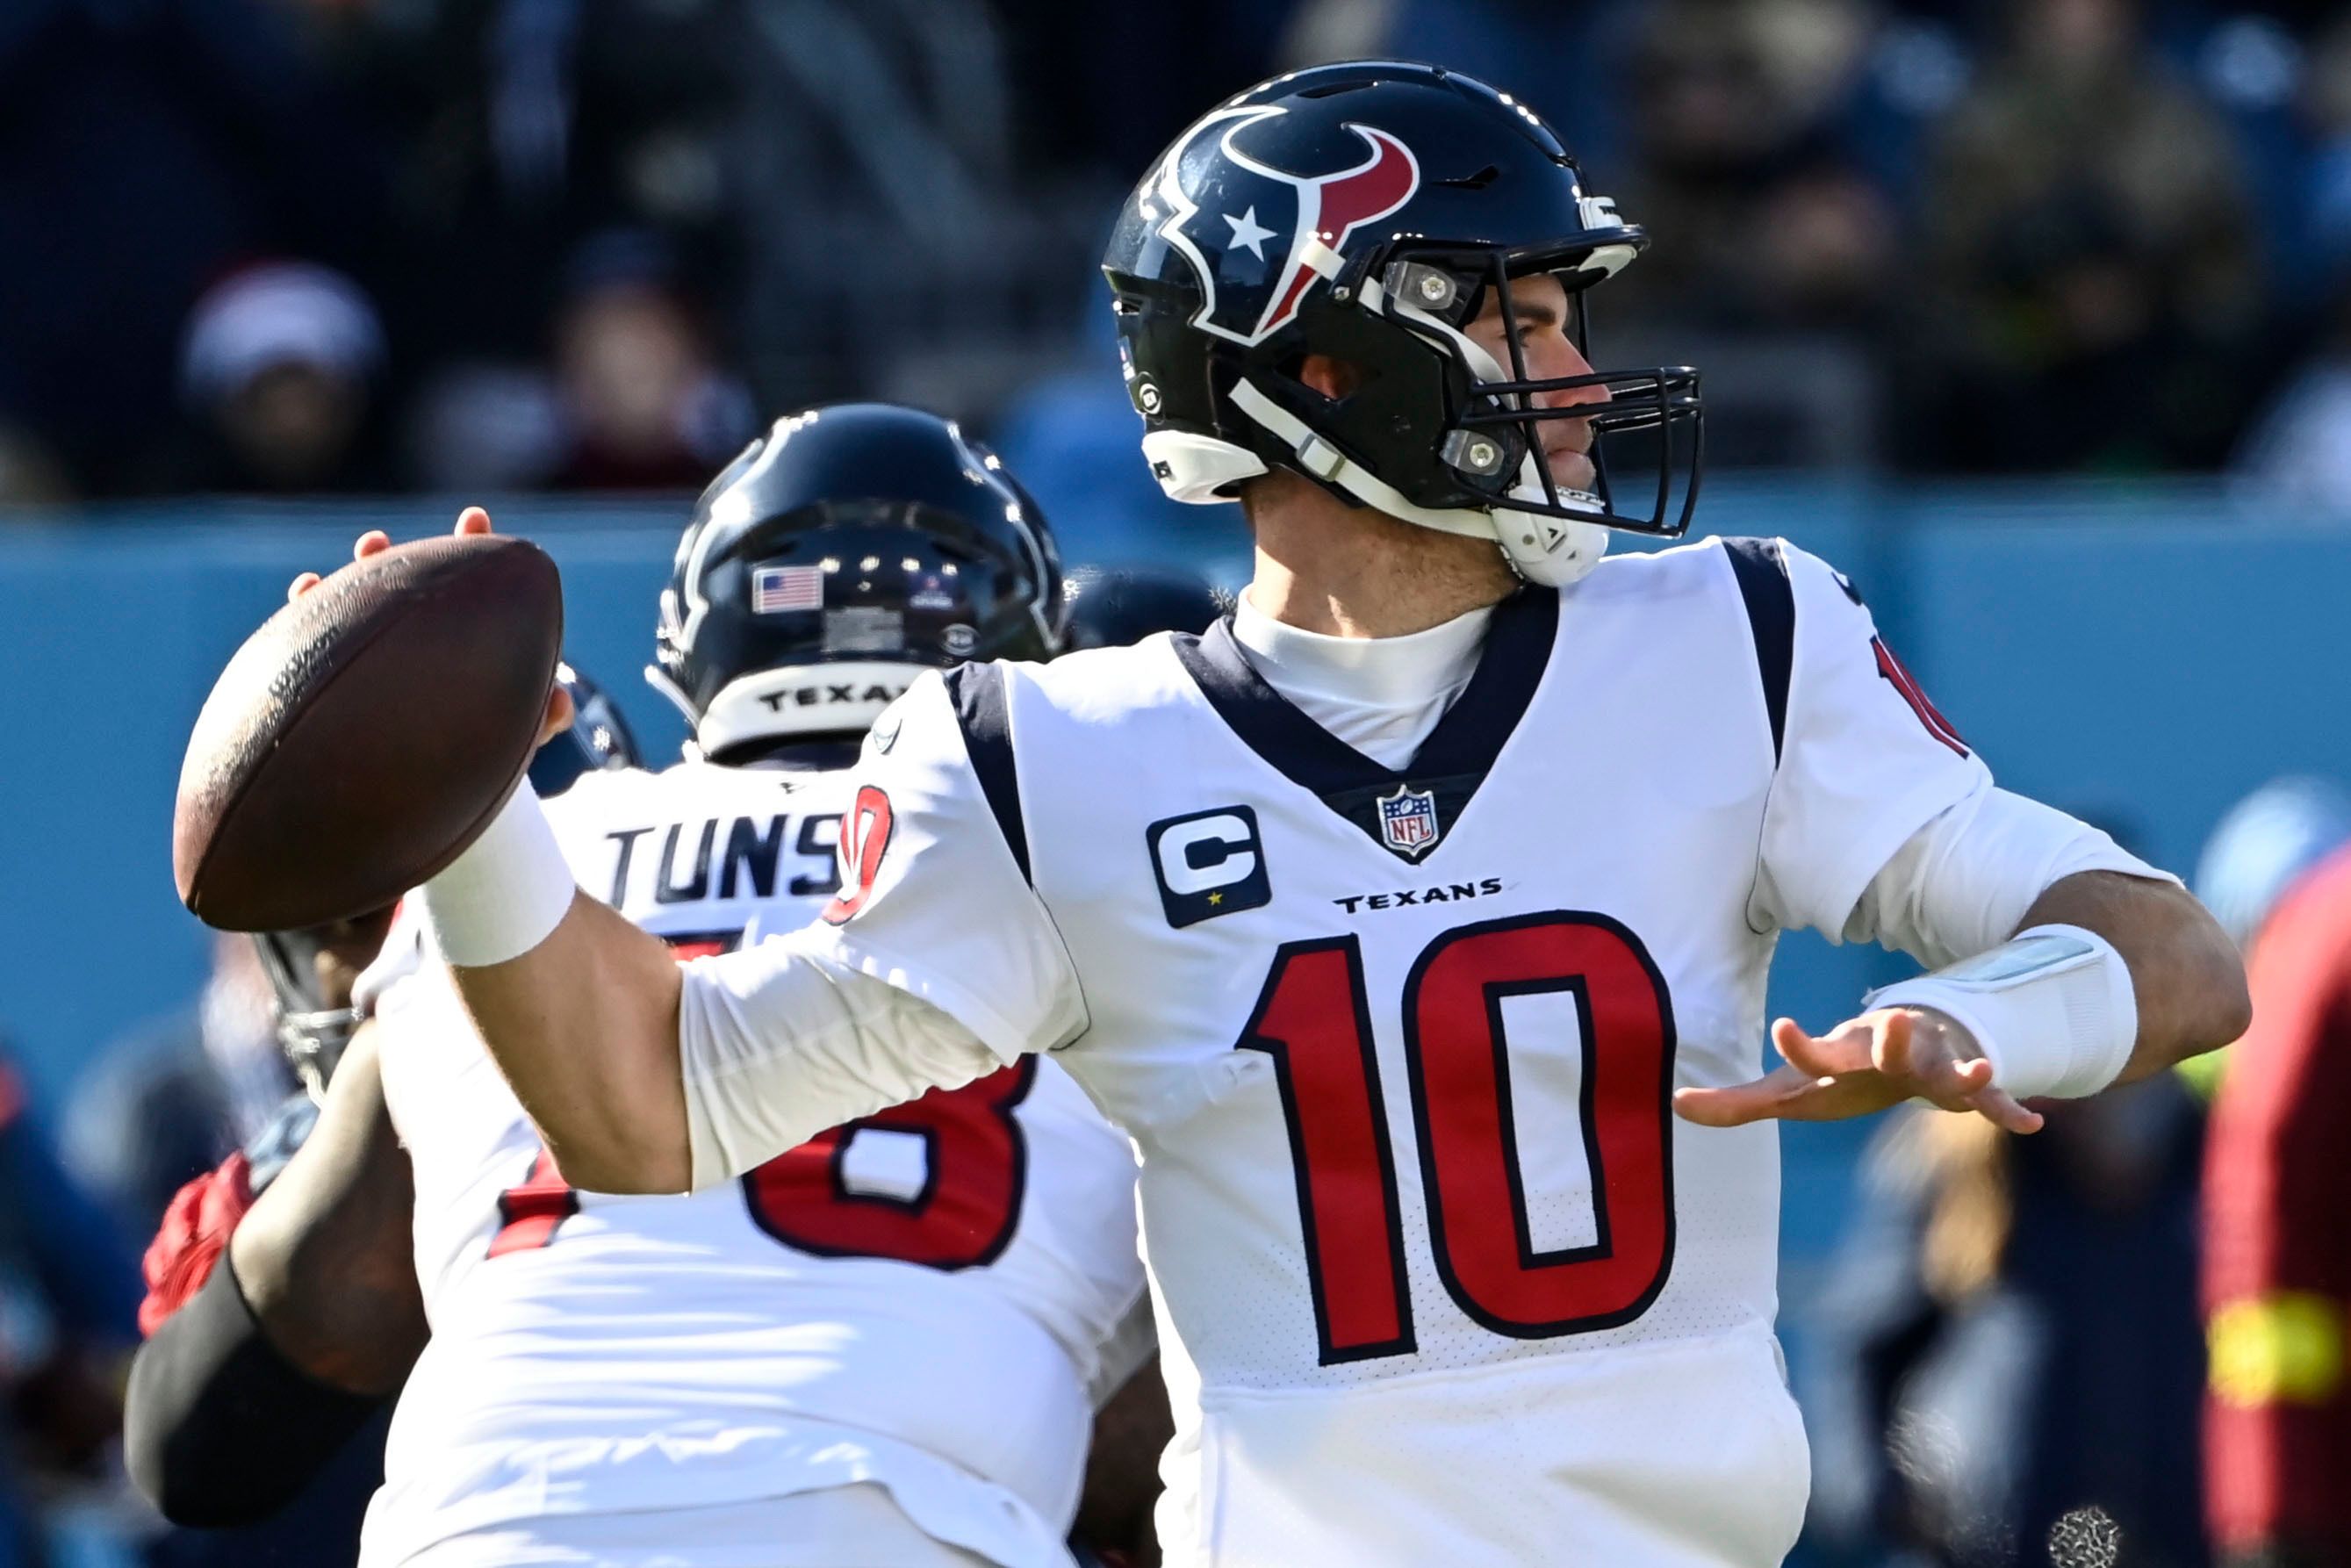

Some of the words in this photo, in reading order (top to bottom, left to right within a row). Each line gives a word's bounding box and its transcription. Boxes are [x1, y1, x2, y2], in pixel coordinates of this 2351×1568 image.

[759, 684, 909, 712] TEXA
[1391, 816, 1431, 843] NFL
[1157, 815, 1256, 895] C
[1333, 878, 1503, 914] TEXANS
[1233, 909, 1677, 1366] 10
